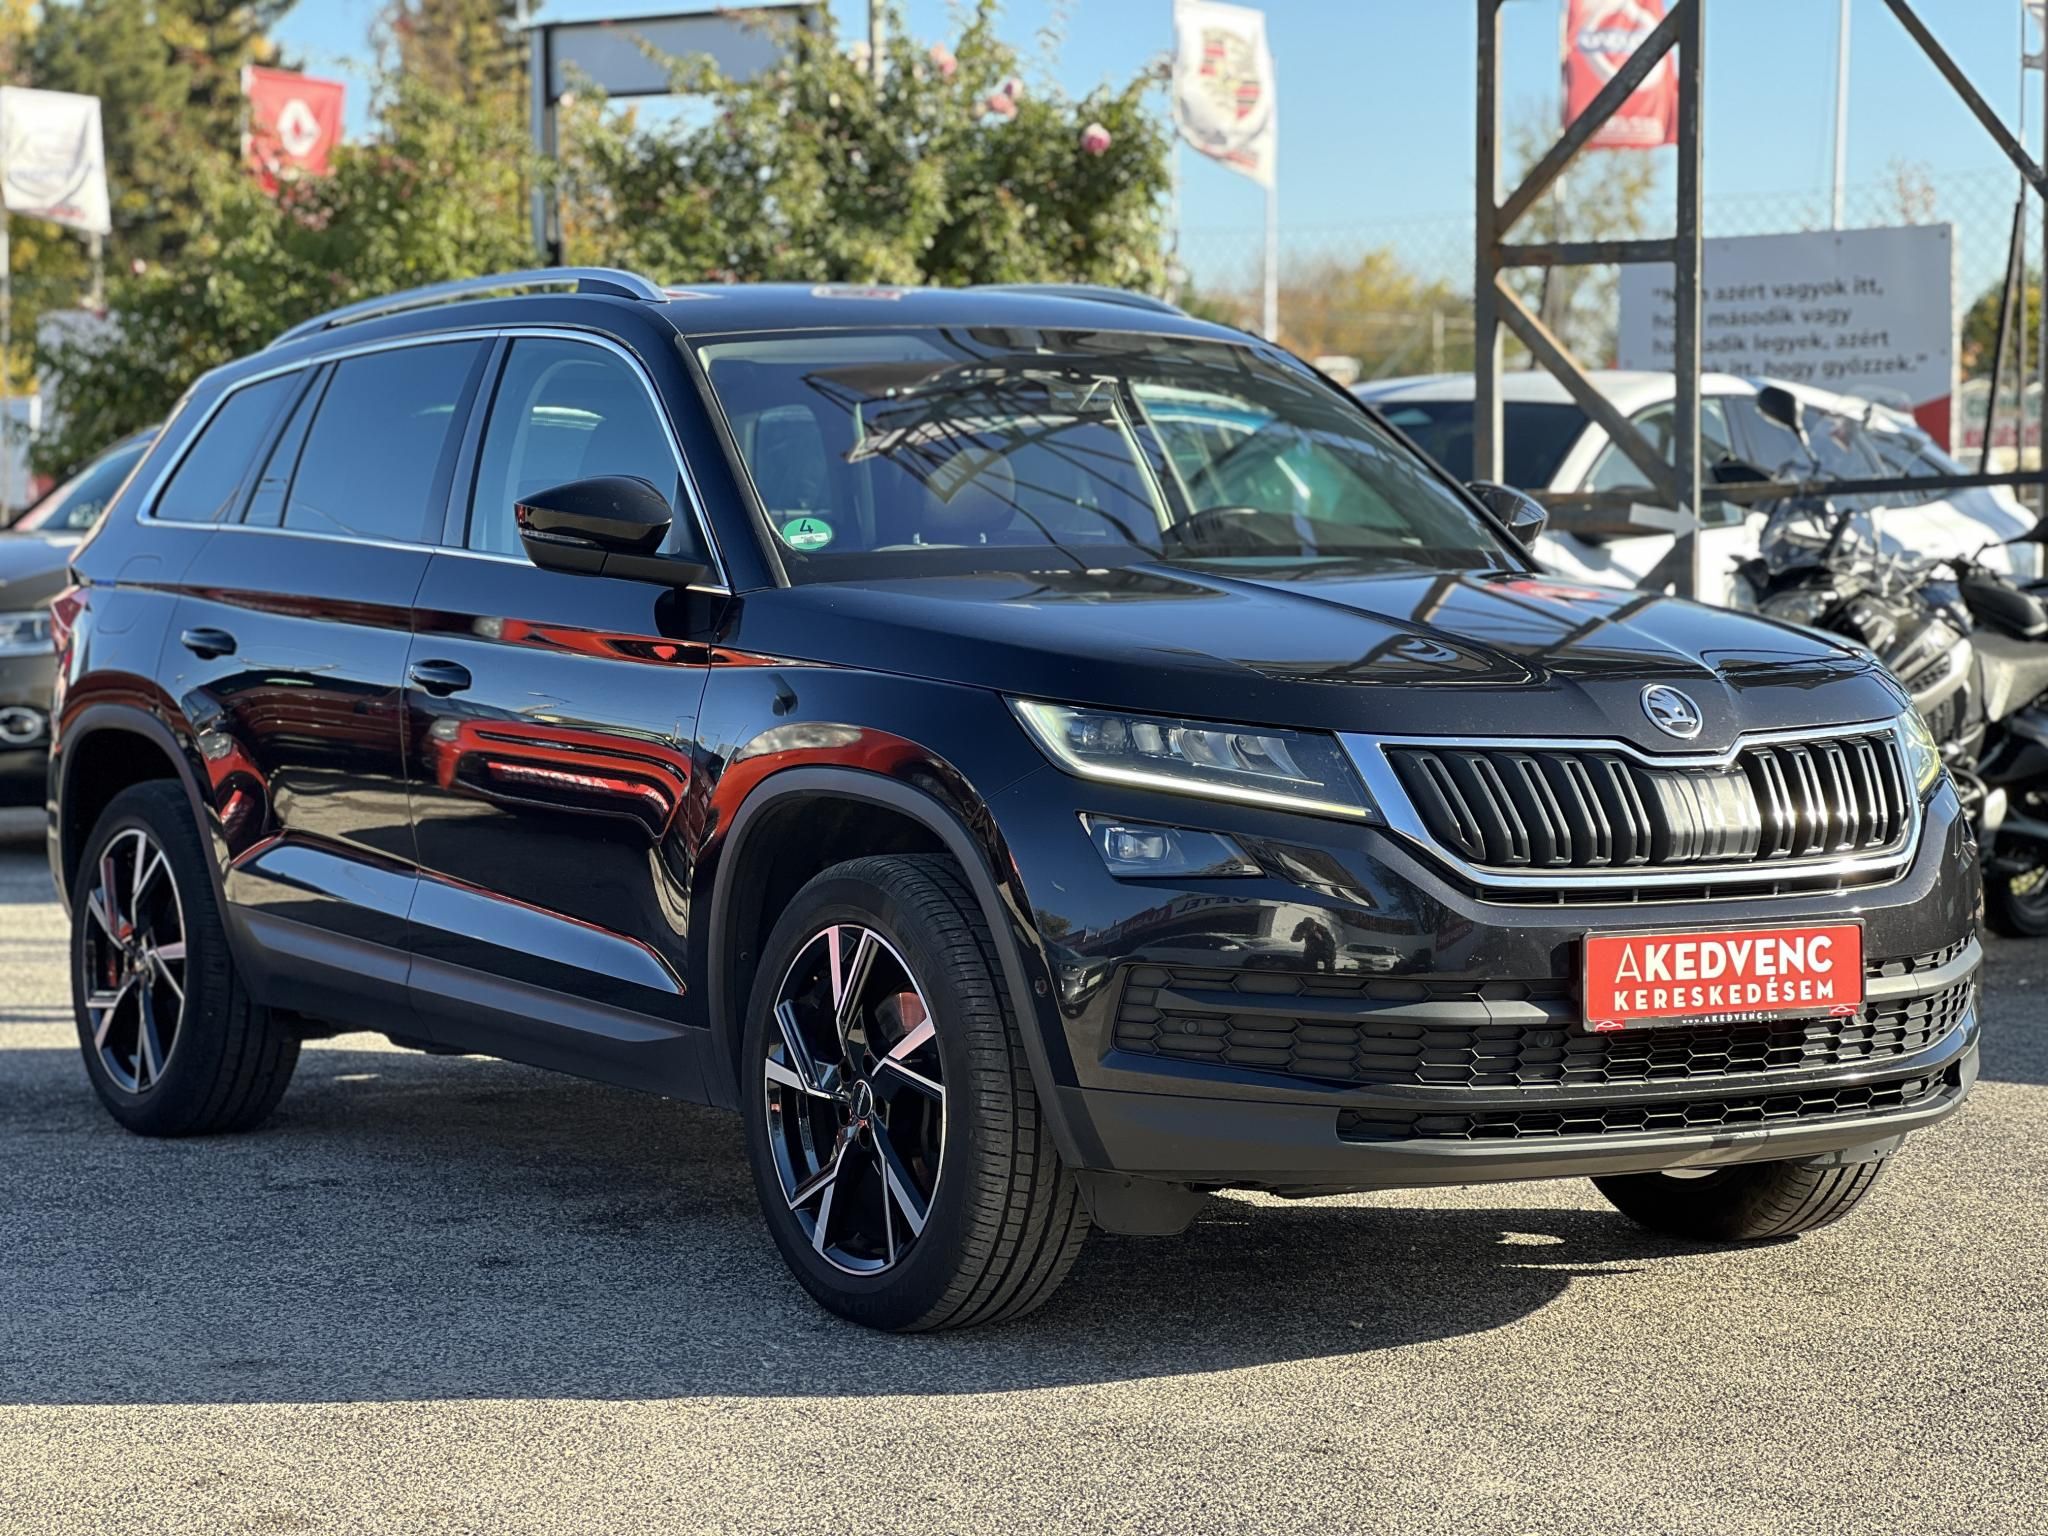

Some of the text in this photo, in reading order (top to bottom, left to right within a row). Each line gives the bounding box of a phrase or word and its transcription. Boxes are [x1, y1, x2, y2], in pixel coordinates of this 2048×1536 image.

[1713, 284, 1764, 301] azért
[1772, 278, 1848, 302] vagyok
[1707, 307, 1794, 328] második
[1801, 307, 1852, 328] vagy
[1652, 333, 1745, 354] haadik
[1836, 328, 1889, 349] azért
[1763, 358, 1816, 381] hogy
[799, 519, 814, 534] 4
[1614, 975, 1834, 1012] KERESKEDÉSEM
